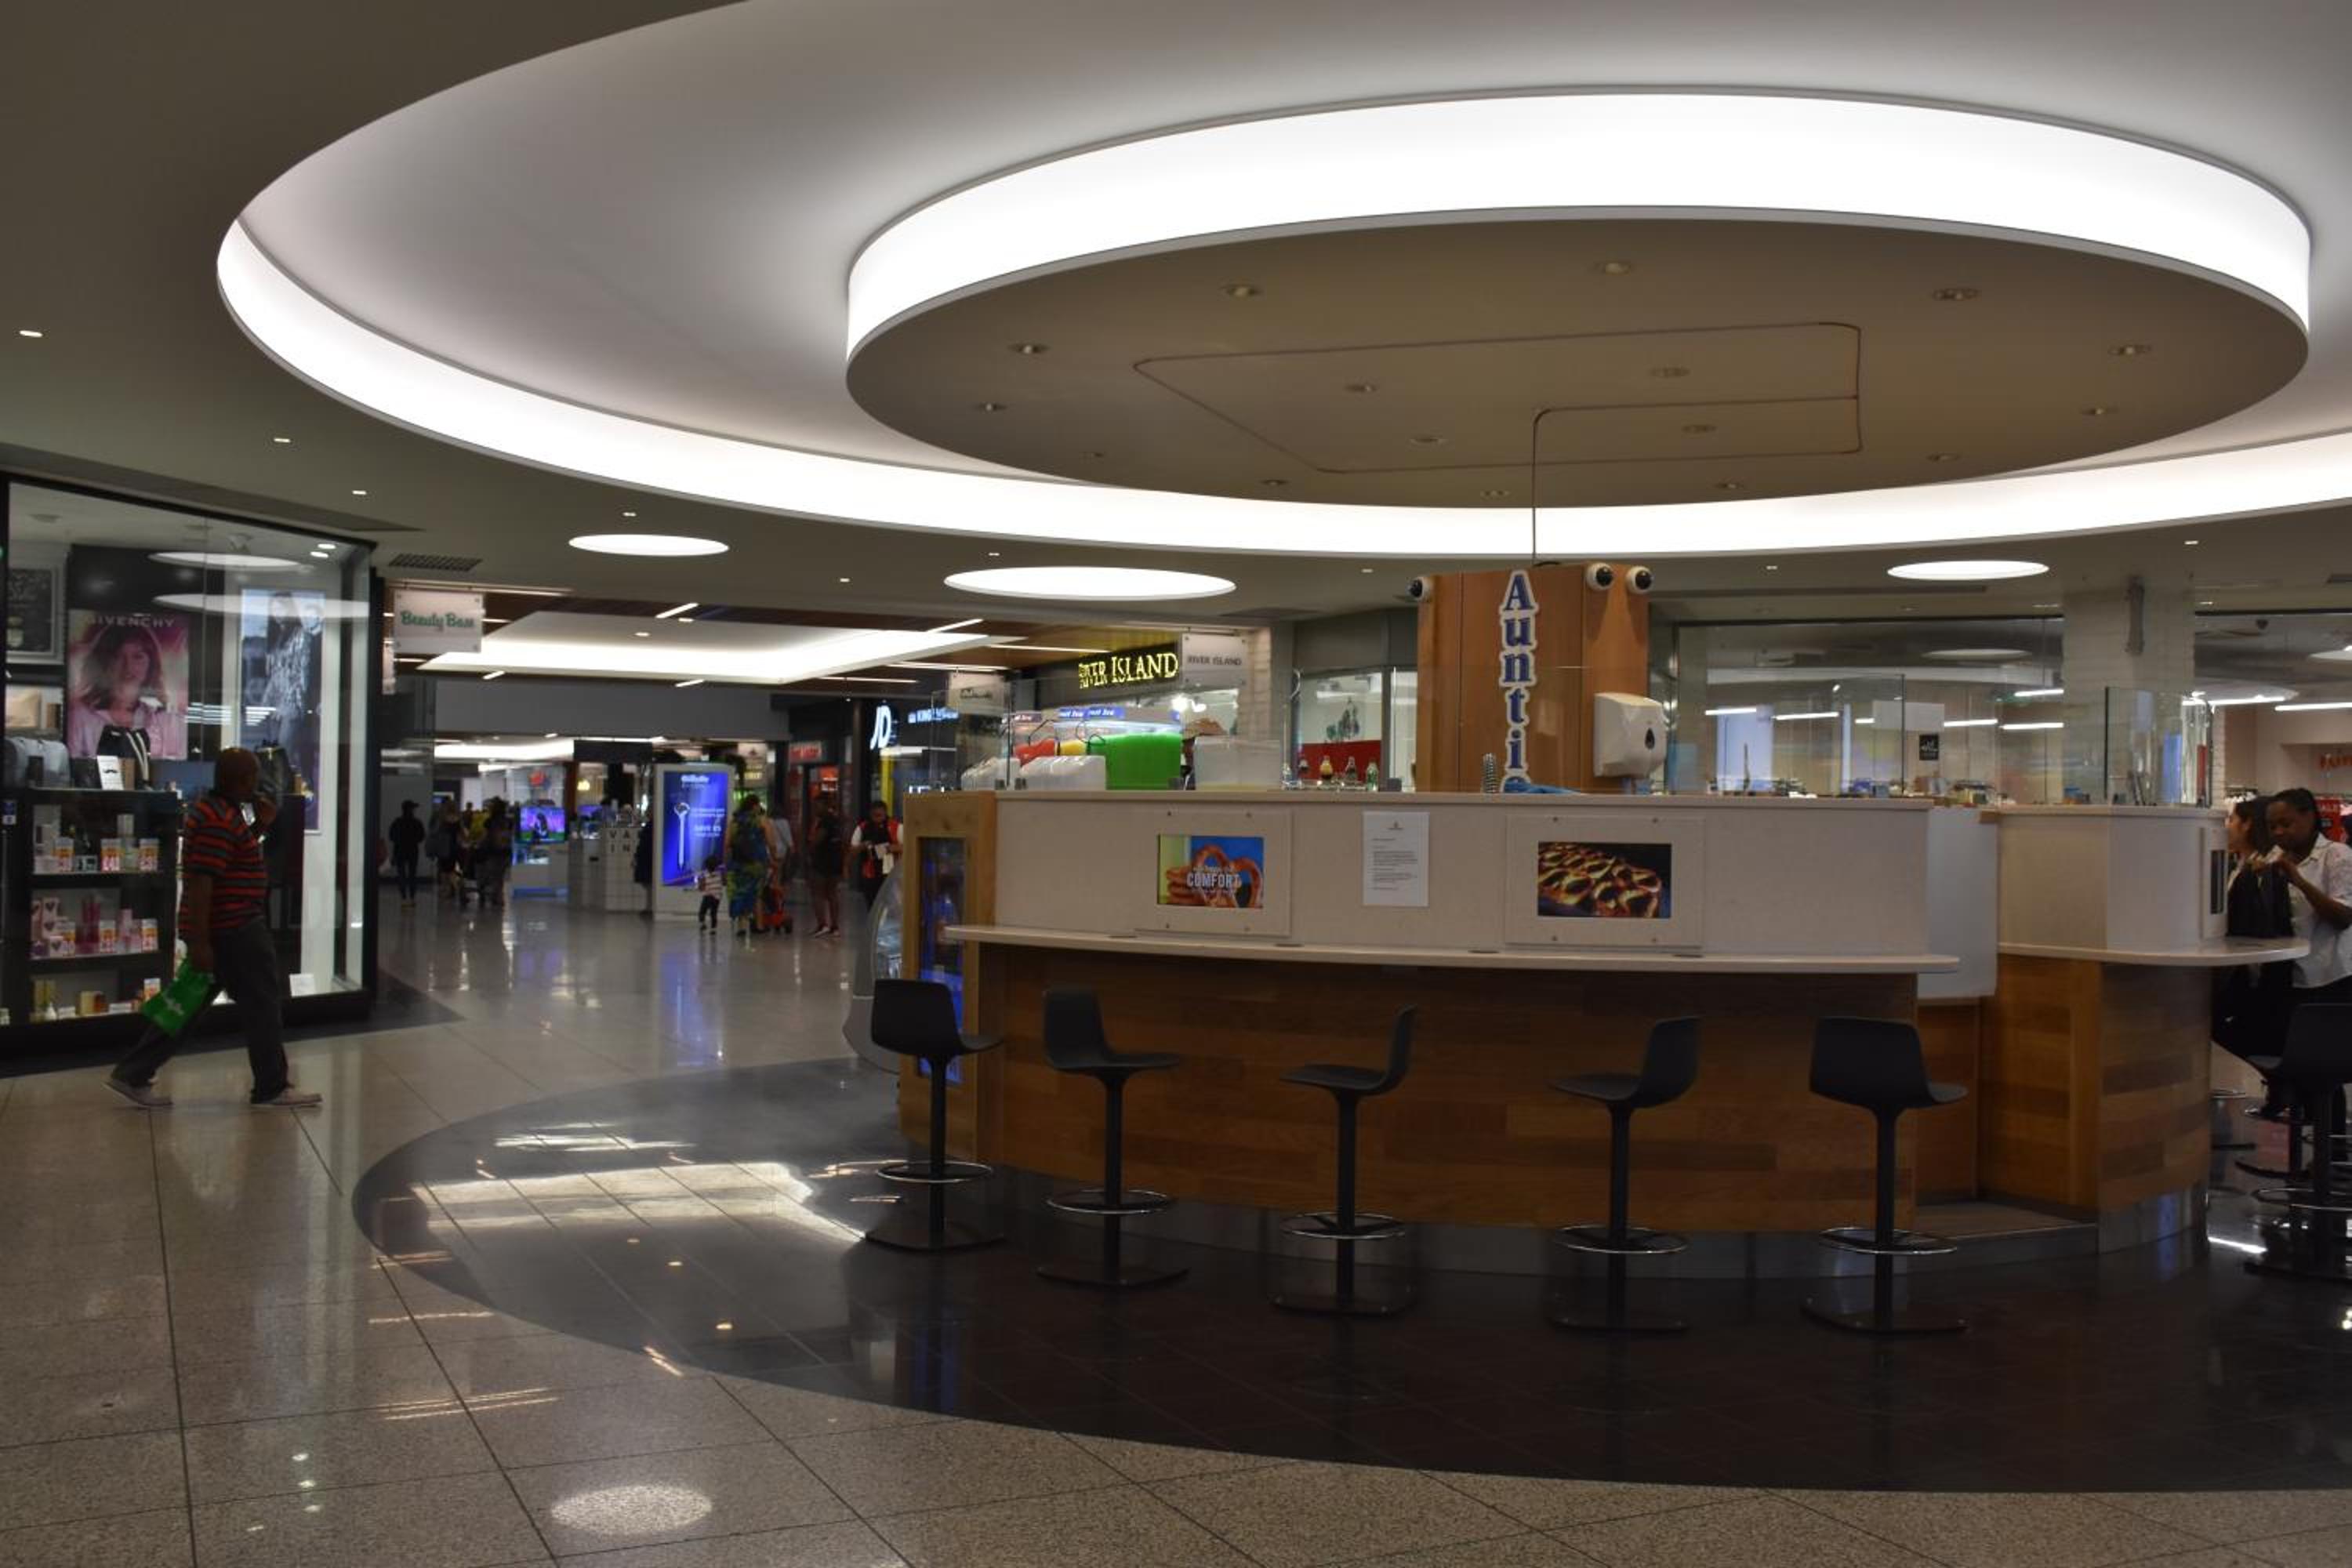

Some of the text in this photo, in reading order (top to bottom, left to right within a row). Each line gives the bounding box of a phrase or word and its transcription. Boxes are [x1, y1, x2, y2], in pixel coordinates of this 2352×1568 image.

[87, 615, 175, 627] GIVENCHY
[400, 610, 474, 632] Beauty Base
[1111, 652, 1178, 683] ISLAND
[1188, 655, 1241, 666] RIVER ISLAND
[1501, 573, 1536, 792] Aunti
[869, 705, 891, 750] JD
[1186, 873, 1243, 888] COMFORT
